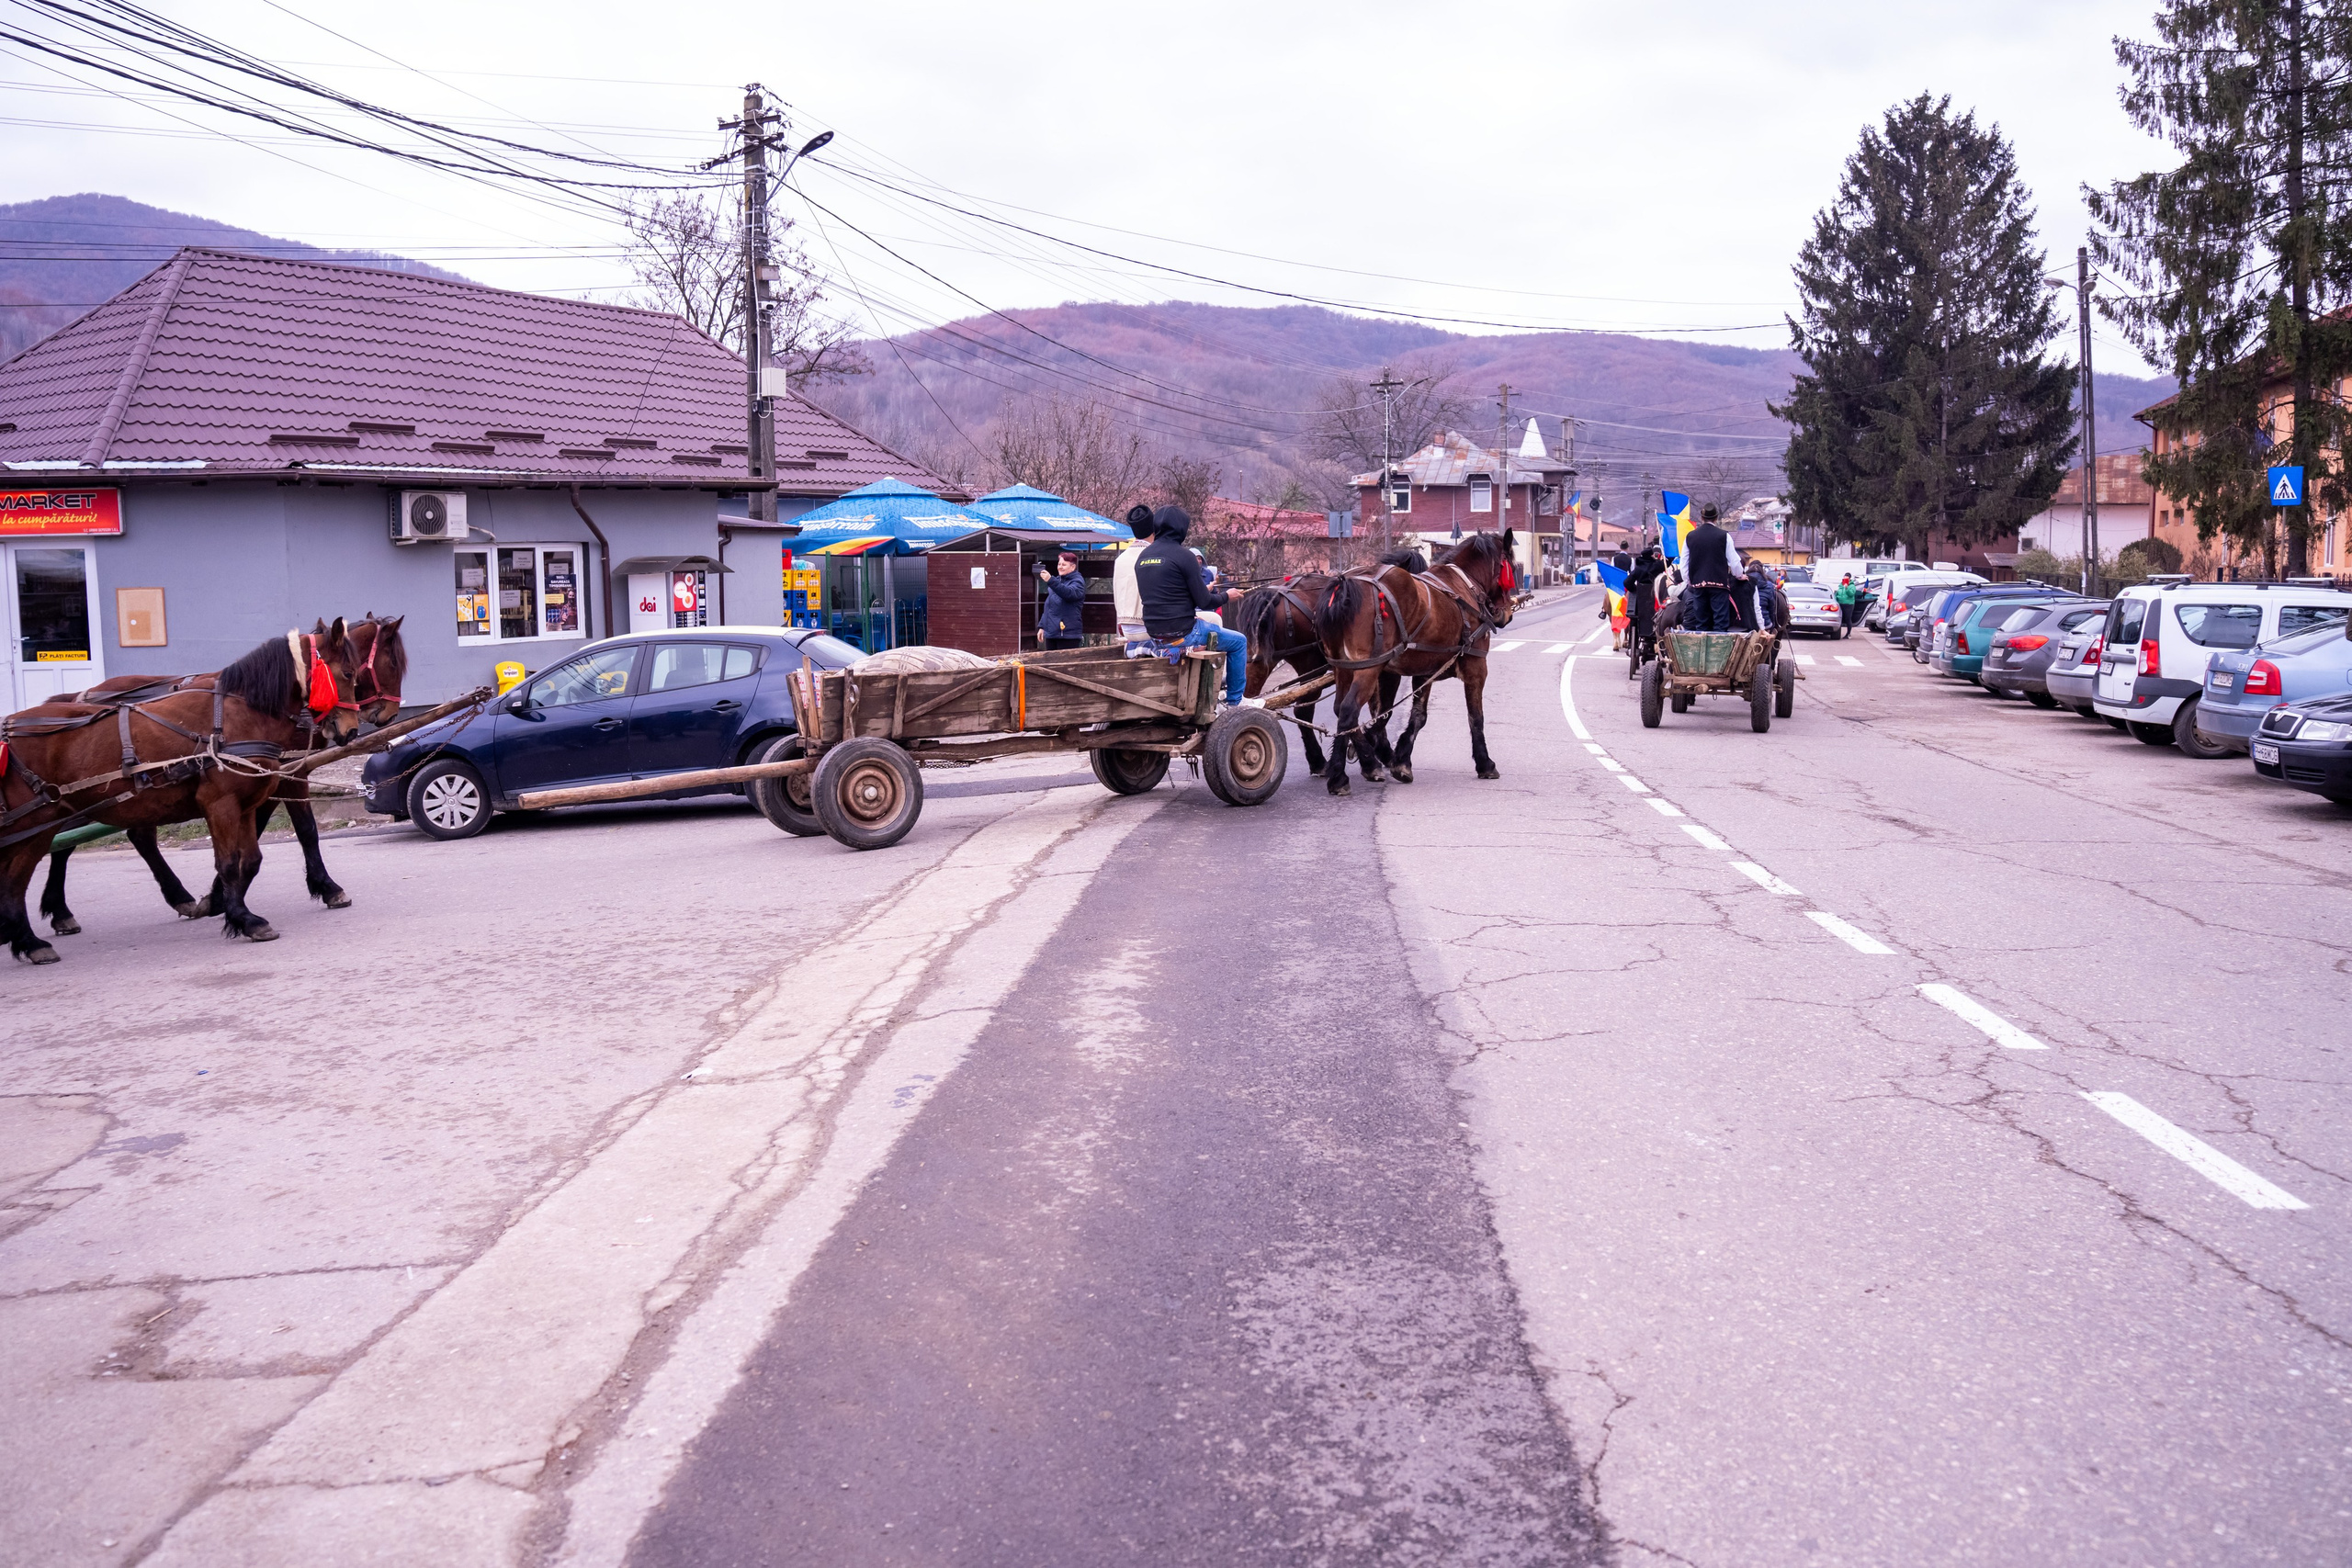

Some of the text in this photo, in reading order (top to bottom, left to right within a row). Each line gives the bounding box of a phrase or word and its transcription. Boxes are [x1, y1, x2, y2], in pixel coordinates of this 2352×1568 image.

[2, 512, 97, 529] la cumpărături!
[639, 596, 657, 613] dai
